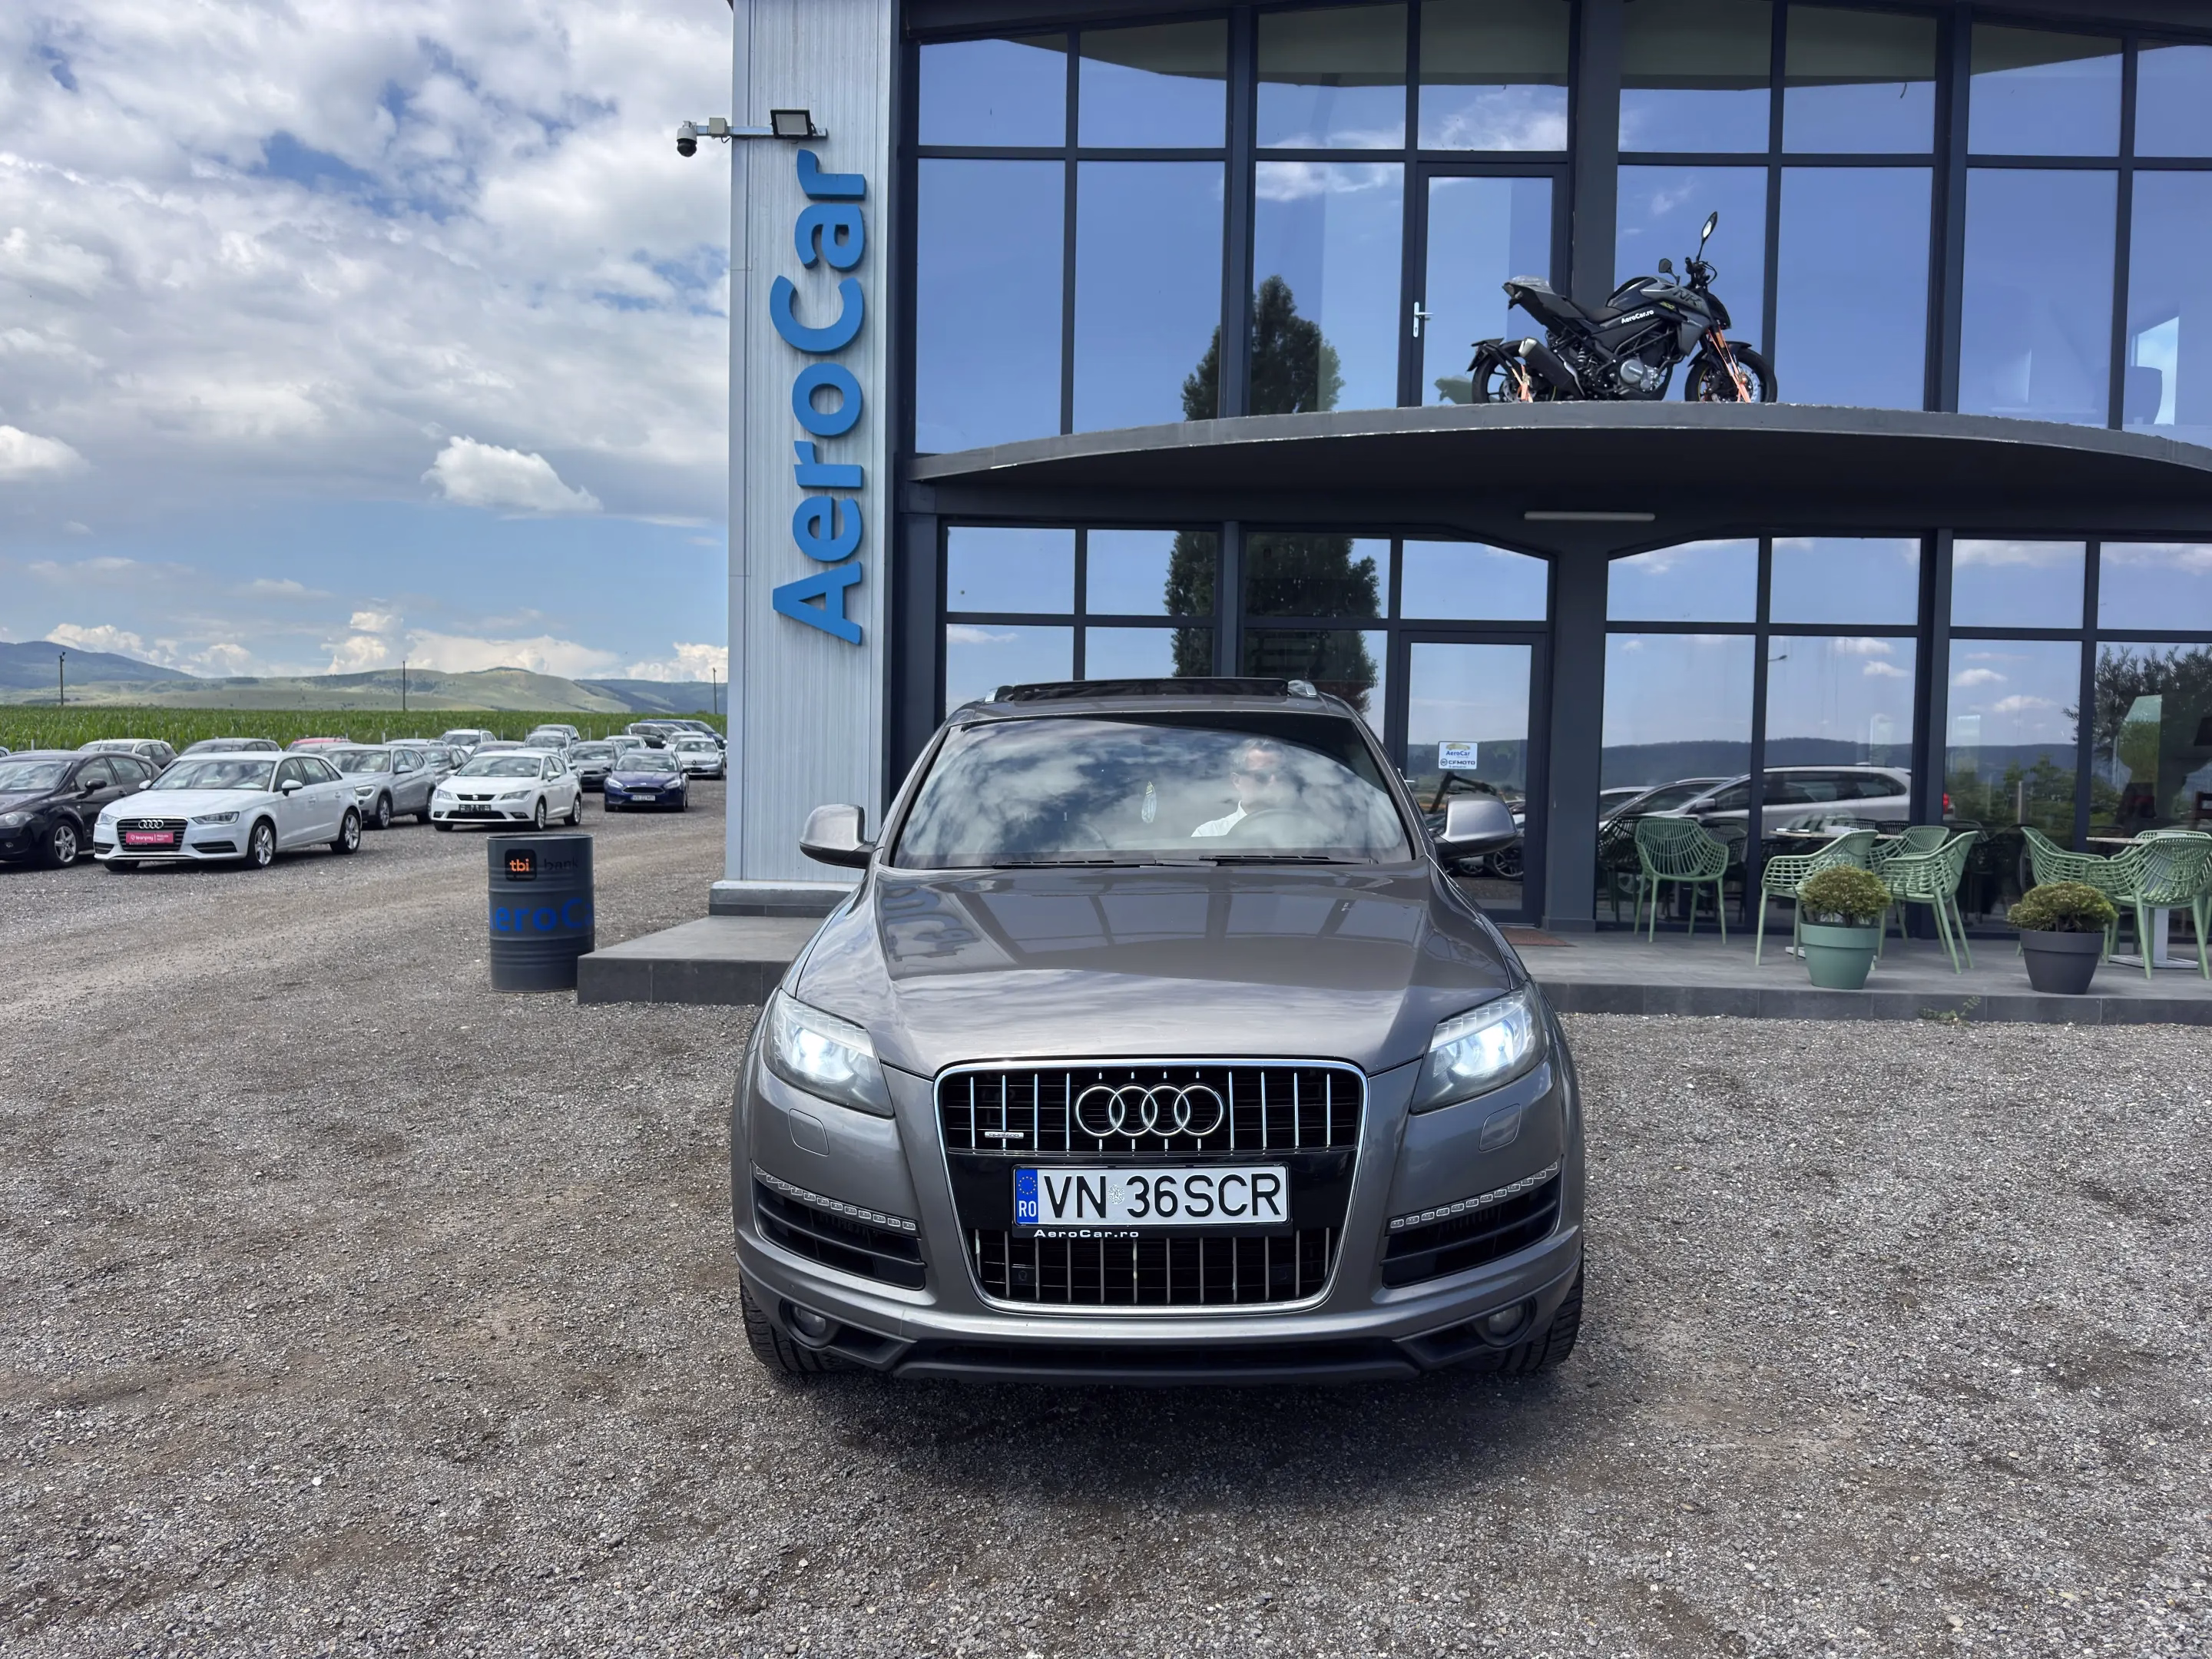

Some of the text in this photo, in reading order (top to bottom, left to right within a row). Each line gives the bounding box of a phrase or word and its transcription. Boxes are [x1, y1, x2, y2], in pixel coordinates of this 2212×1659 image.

[1621, 310, 1654, 323] AeroCar.ro
[770, 148, 866, 647] AeroCar
[509, 856, 578, 872] tbi bank
[1044, 1175, 1107, 1218] VN
[1018, 1200, 1037, 1217] RO
[1034, 1229, 1139, 1238] AeroCar.ro
